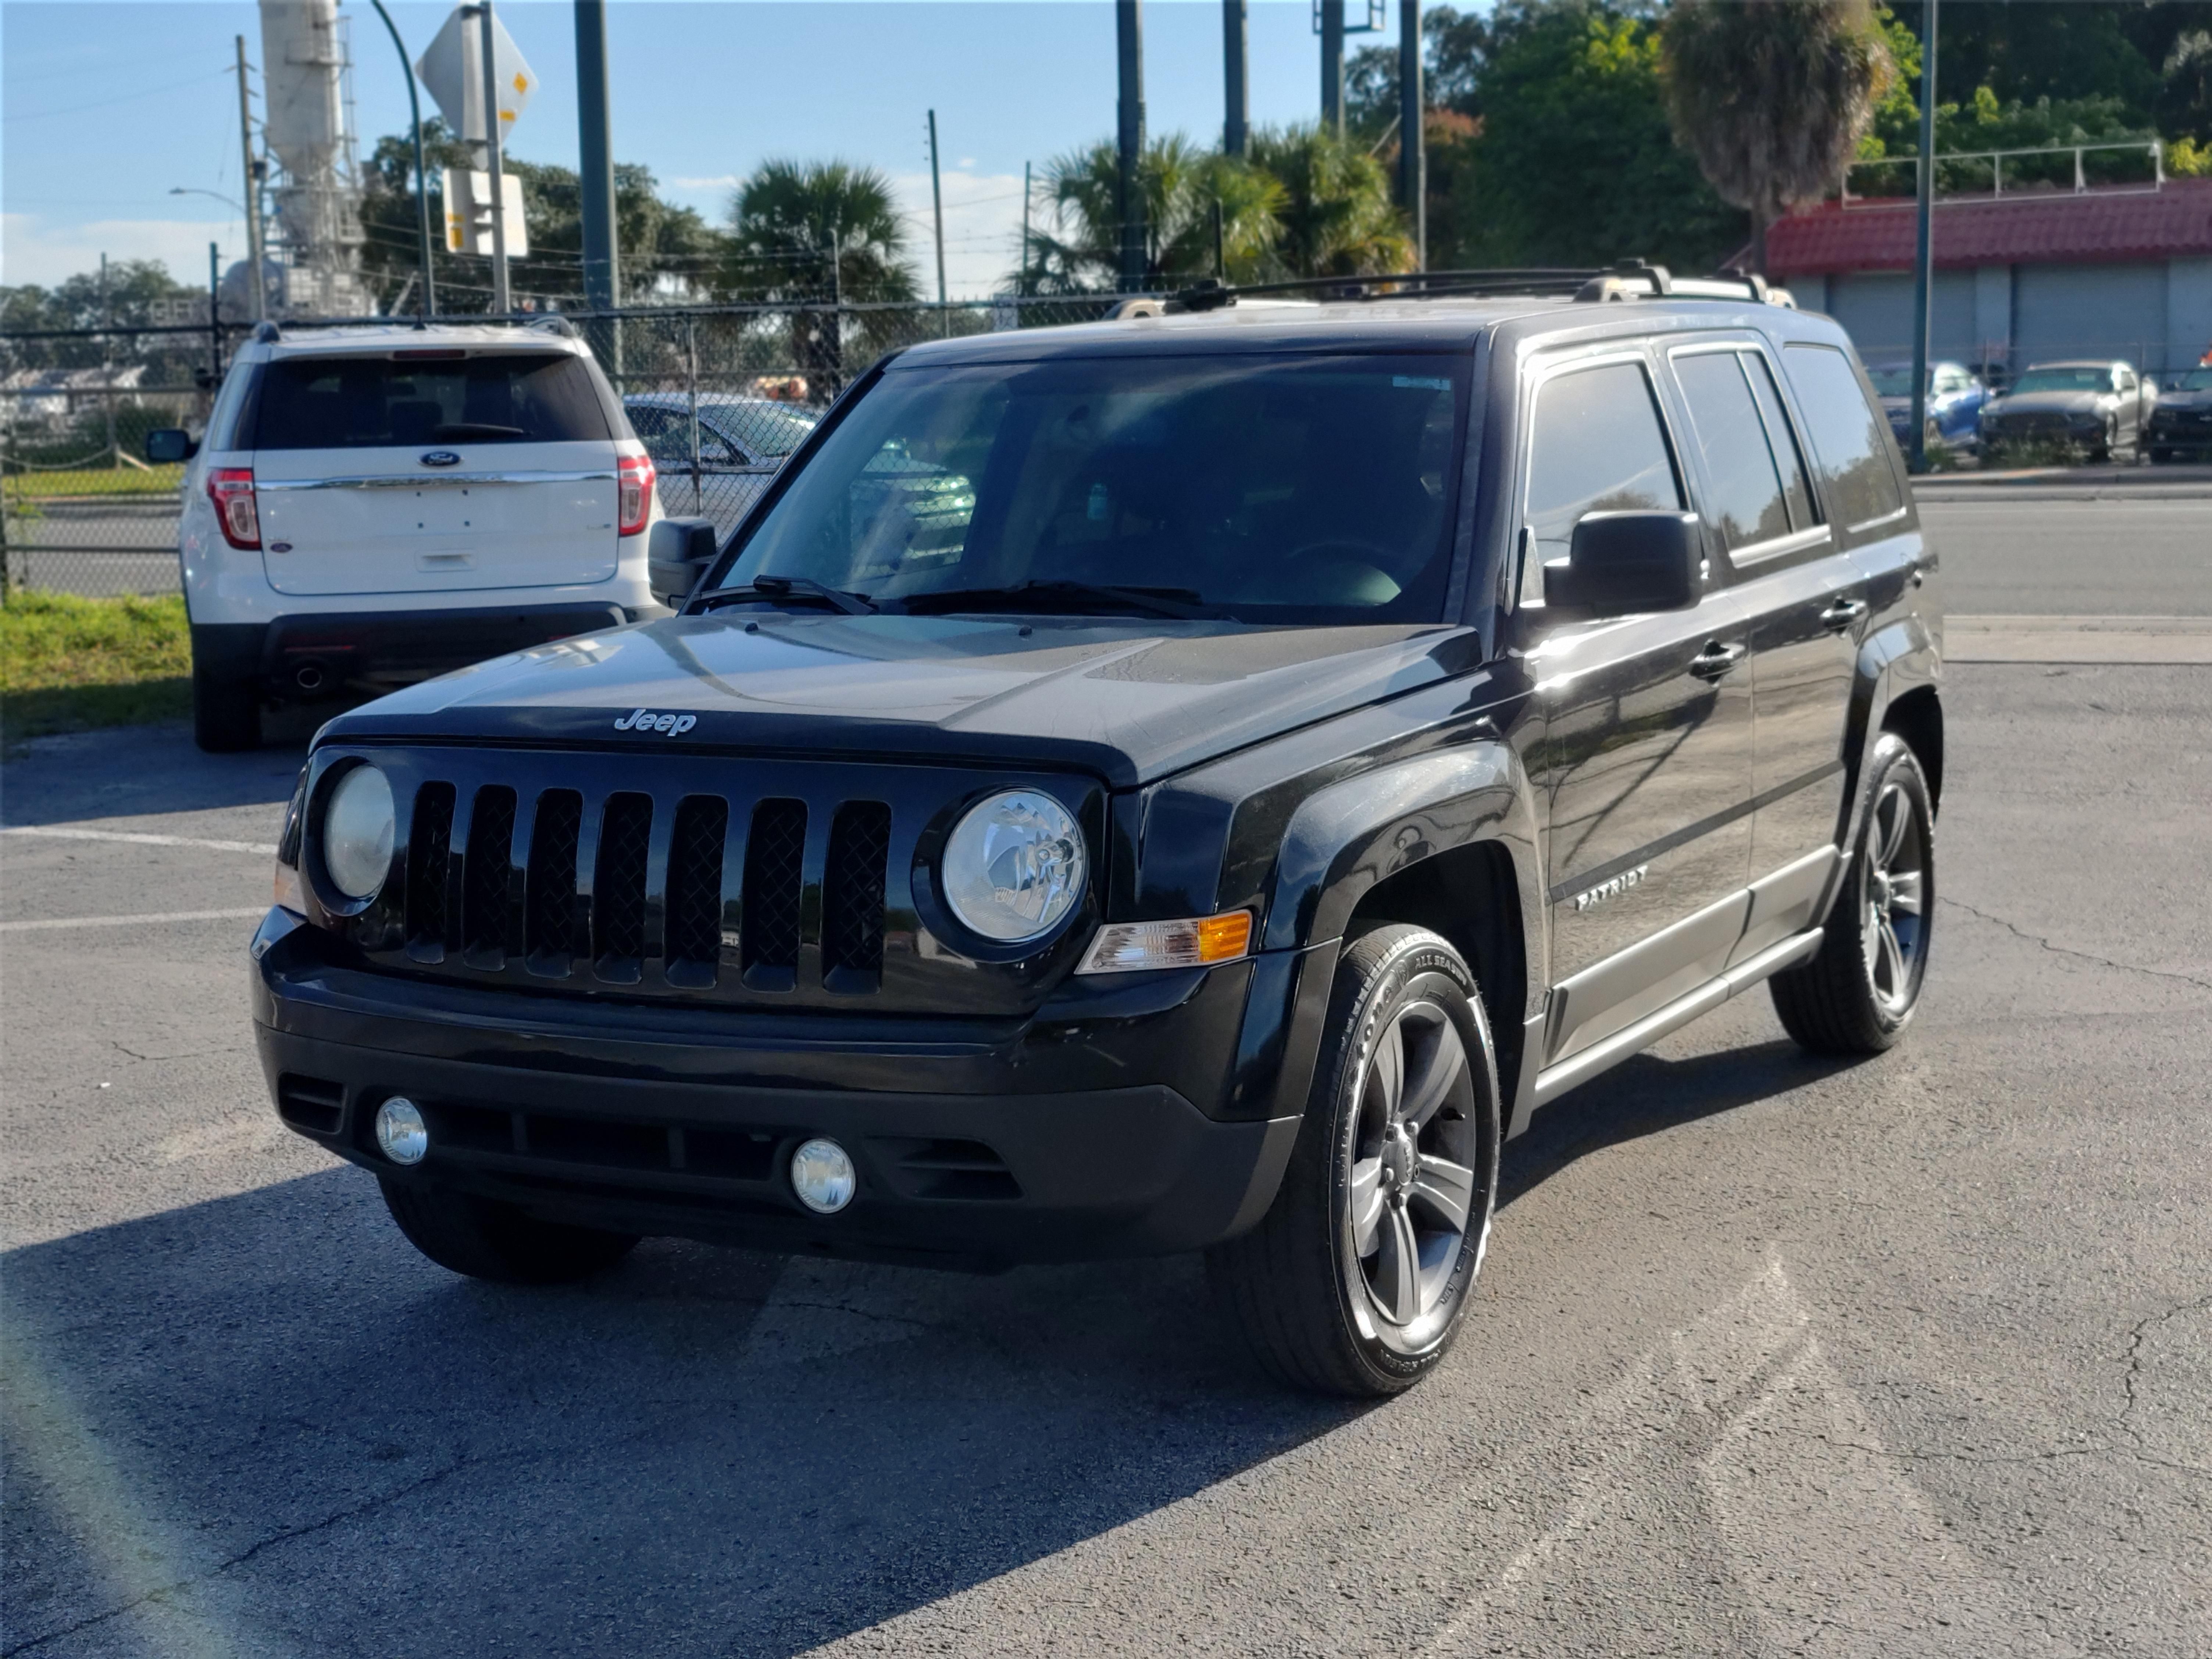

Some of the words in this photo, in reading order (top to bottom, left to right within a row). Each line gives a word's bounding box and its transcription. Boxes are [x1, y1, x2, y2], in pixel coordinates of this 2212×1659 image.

[614, 709, 697, 737] Jeep
[1575, 865, 1648, 911] PATRIOT
[1415, 955, 1433, 969] ALL
[1434, 955, 1467, 986] SEASON
